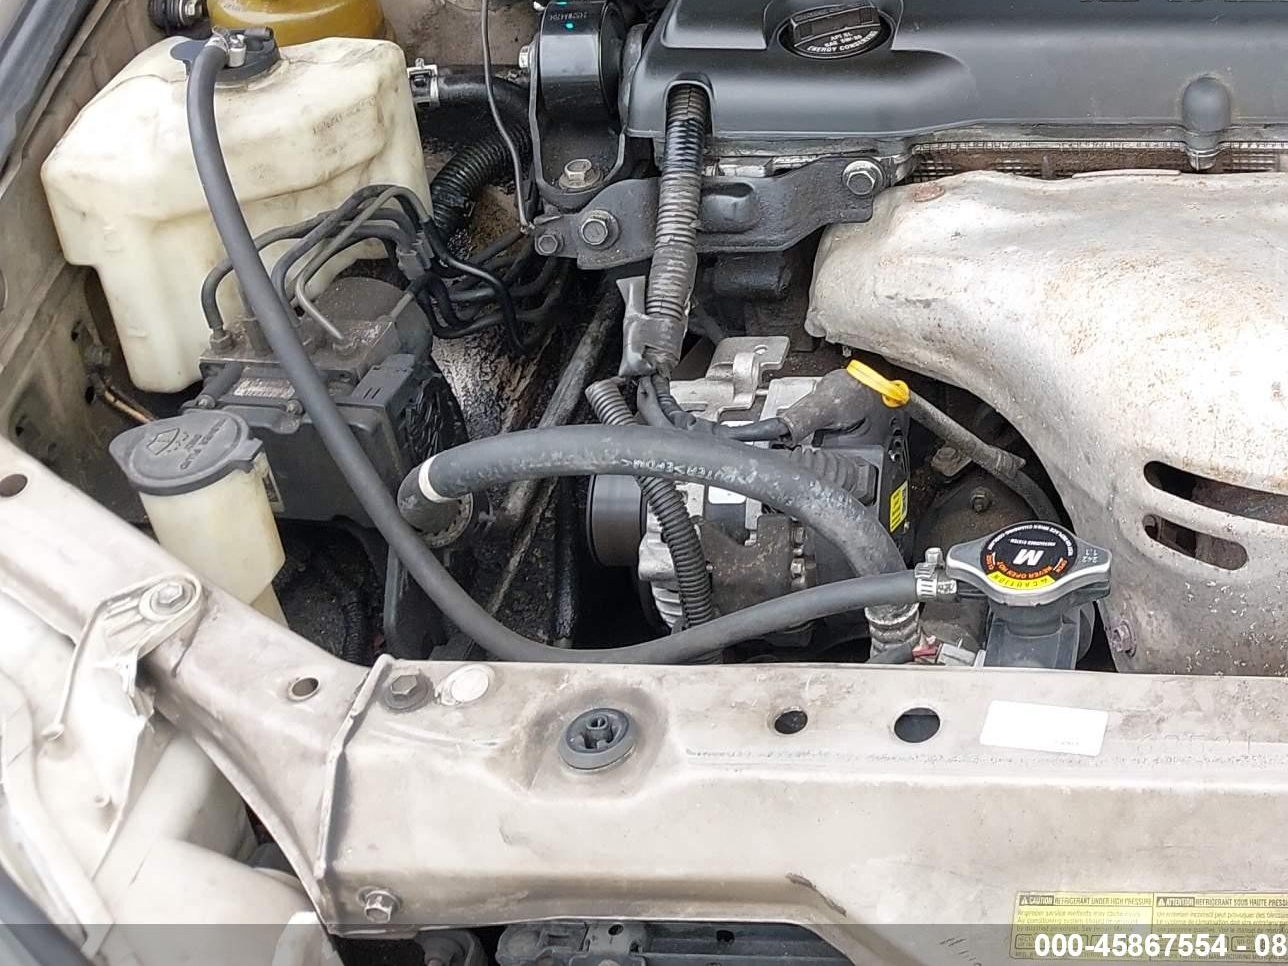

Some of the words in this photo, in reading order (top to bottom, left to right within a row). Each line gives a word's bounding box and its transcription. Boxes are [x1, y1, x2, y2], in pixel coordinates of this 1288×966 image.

[1013, 549, 1044, 566] M
[1008, 571, 1027, 579] OPEN
[993, 574, 1039, 588] CAUTION
[1028, 896, 1054, 905] CAUTION
[1055, 897, 1090, 905] REFRIGERANT
[1091, 897, 1110, 905] UNDER
[1125, 898, 1152, 906] PRESSURE
[1250, 899, 1268, 907] HAUTE
